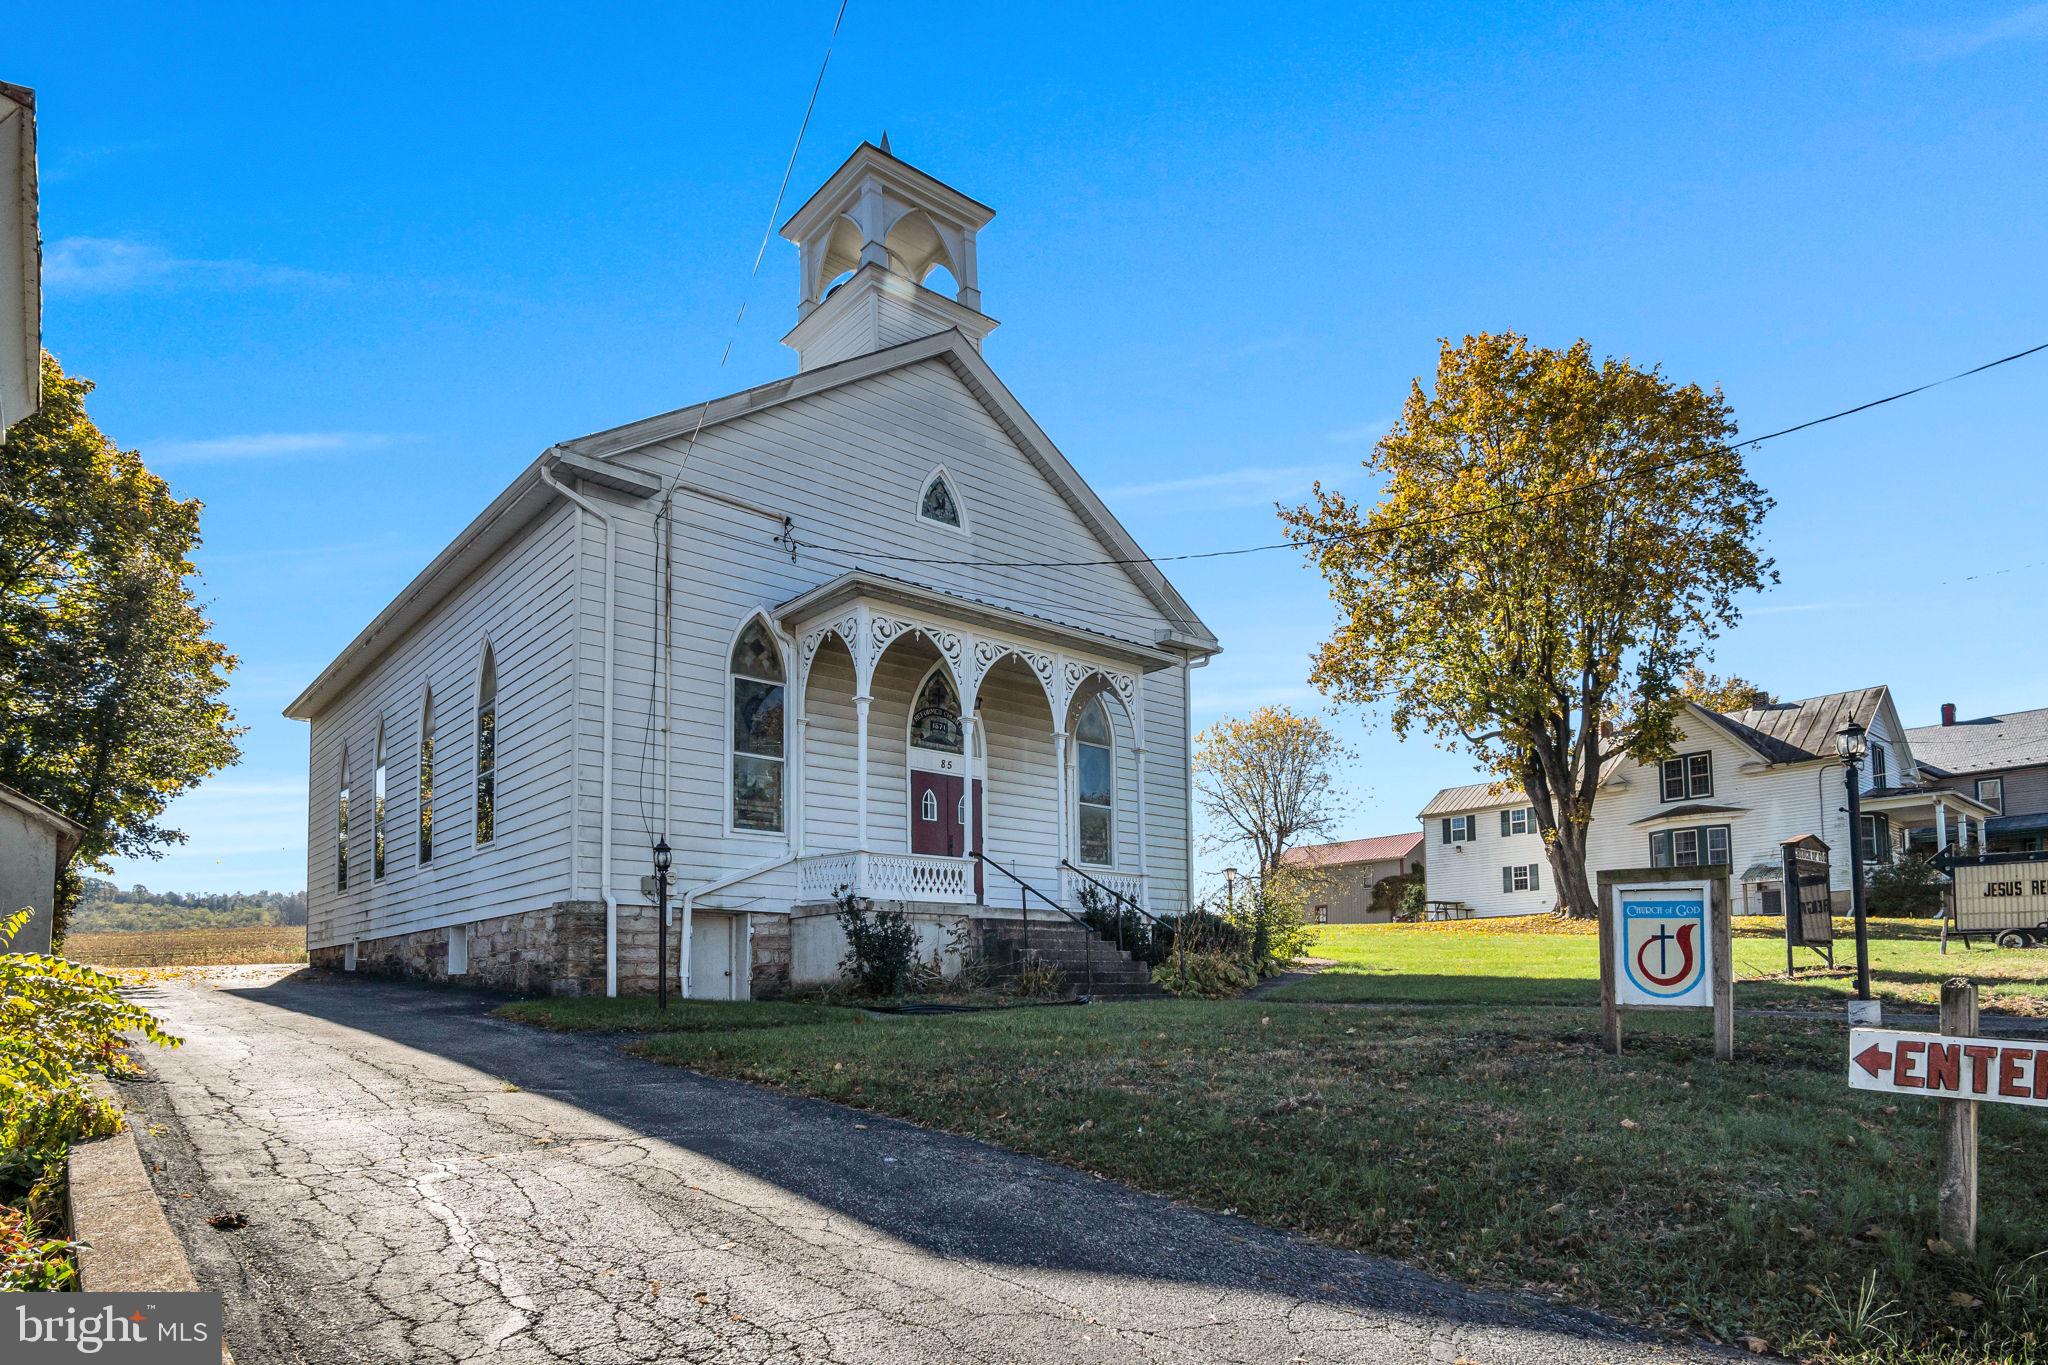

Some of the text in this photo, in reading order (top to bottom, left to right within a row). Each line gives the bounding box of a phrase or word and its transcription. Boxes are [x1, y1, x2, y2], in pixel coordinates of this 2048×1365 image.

[941, 760, 952, 769] 85
[1984, 880, 2048, 897] JESUS RE
[1675, 904, 1701, 917] GOD
